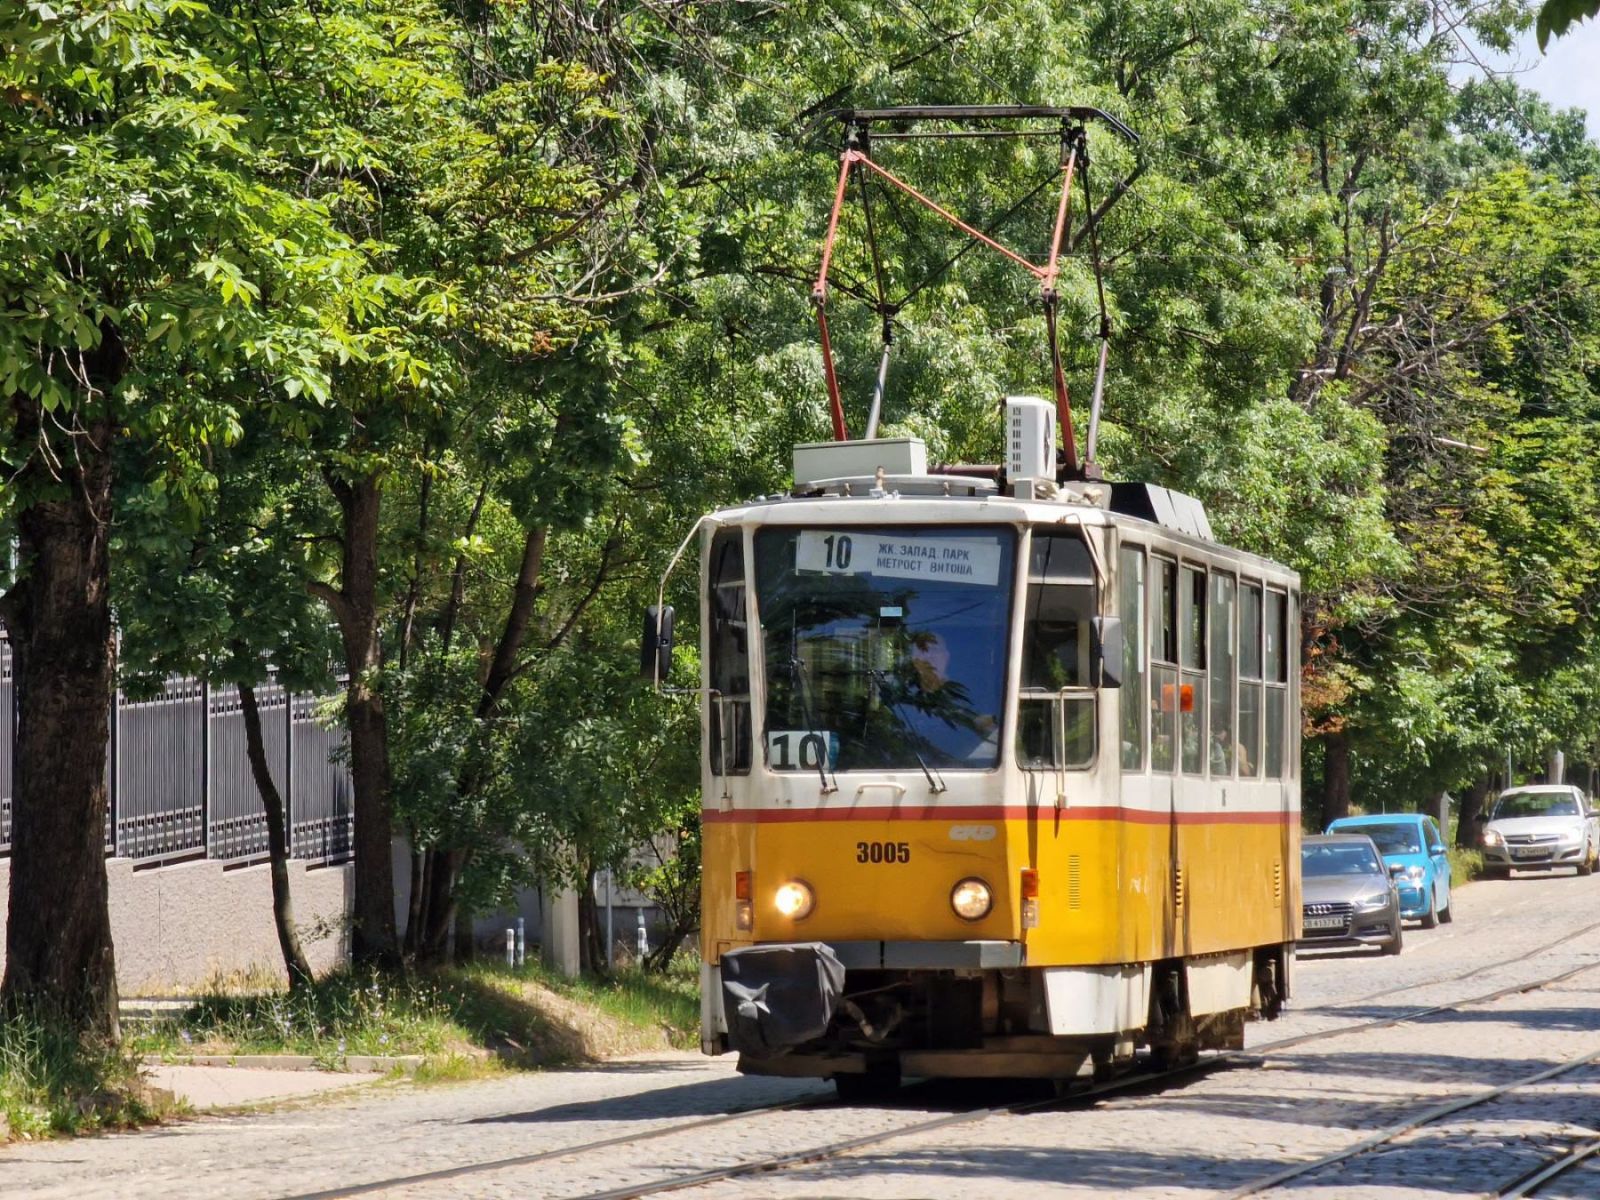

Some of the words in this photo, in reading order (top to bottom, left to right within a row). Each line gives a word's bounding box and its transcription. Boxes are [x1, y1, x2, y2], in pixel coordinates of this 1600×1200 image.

[823, 534, 853, 570] 10
[942, 547, 970, 561] ПАРК
[772, 733, 826, 771] 10
[856, 841, 910, 864] 3005
